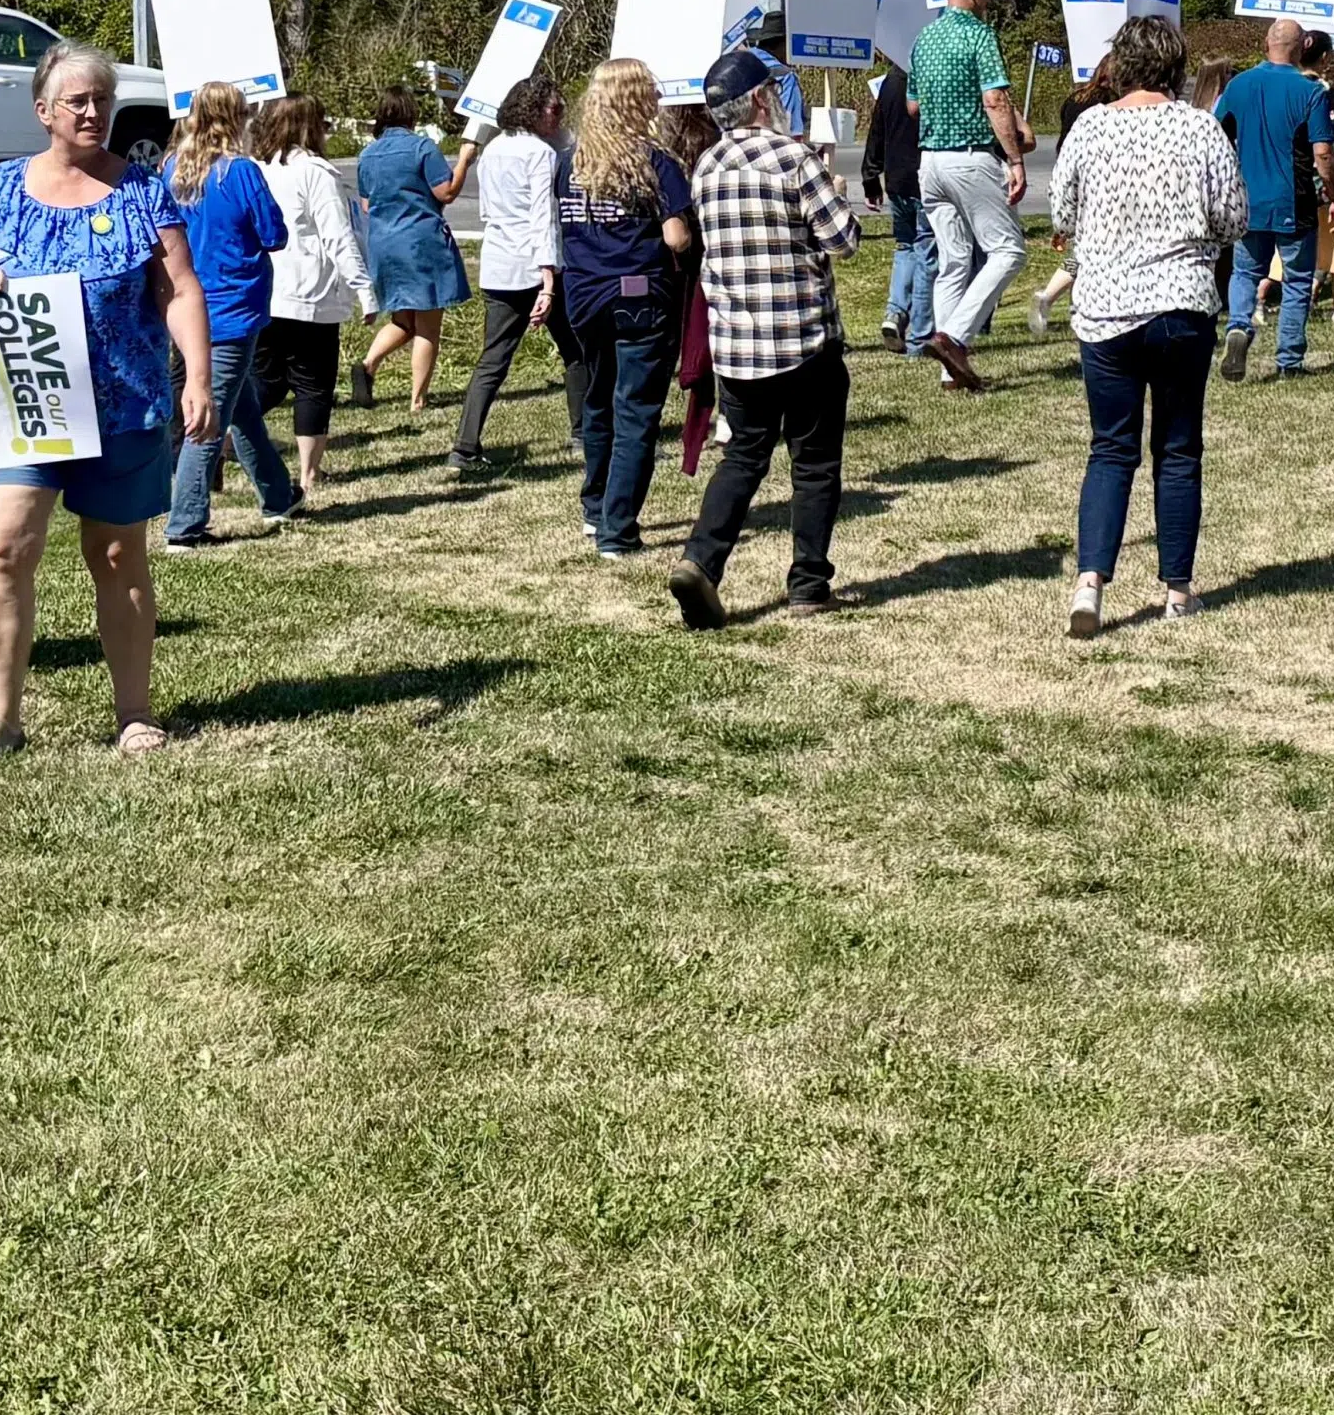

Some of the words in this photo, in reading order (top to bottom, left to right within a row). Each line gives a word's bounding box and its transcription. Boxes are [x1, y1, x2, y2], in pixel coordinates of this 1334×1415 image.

[1038, 45, 1060, 64] 376
[17, 292, 71, 391] SAVE
[45, 393, 69, 431] our
